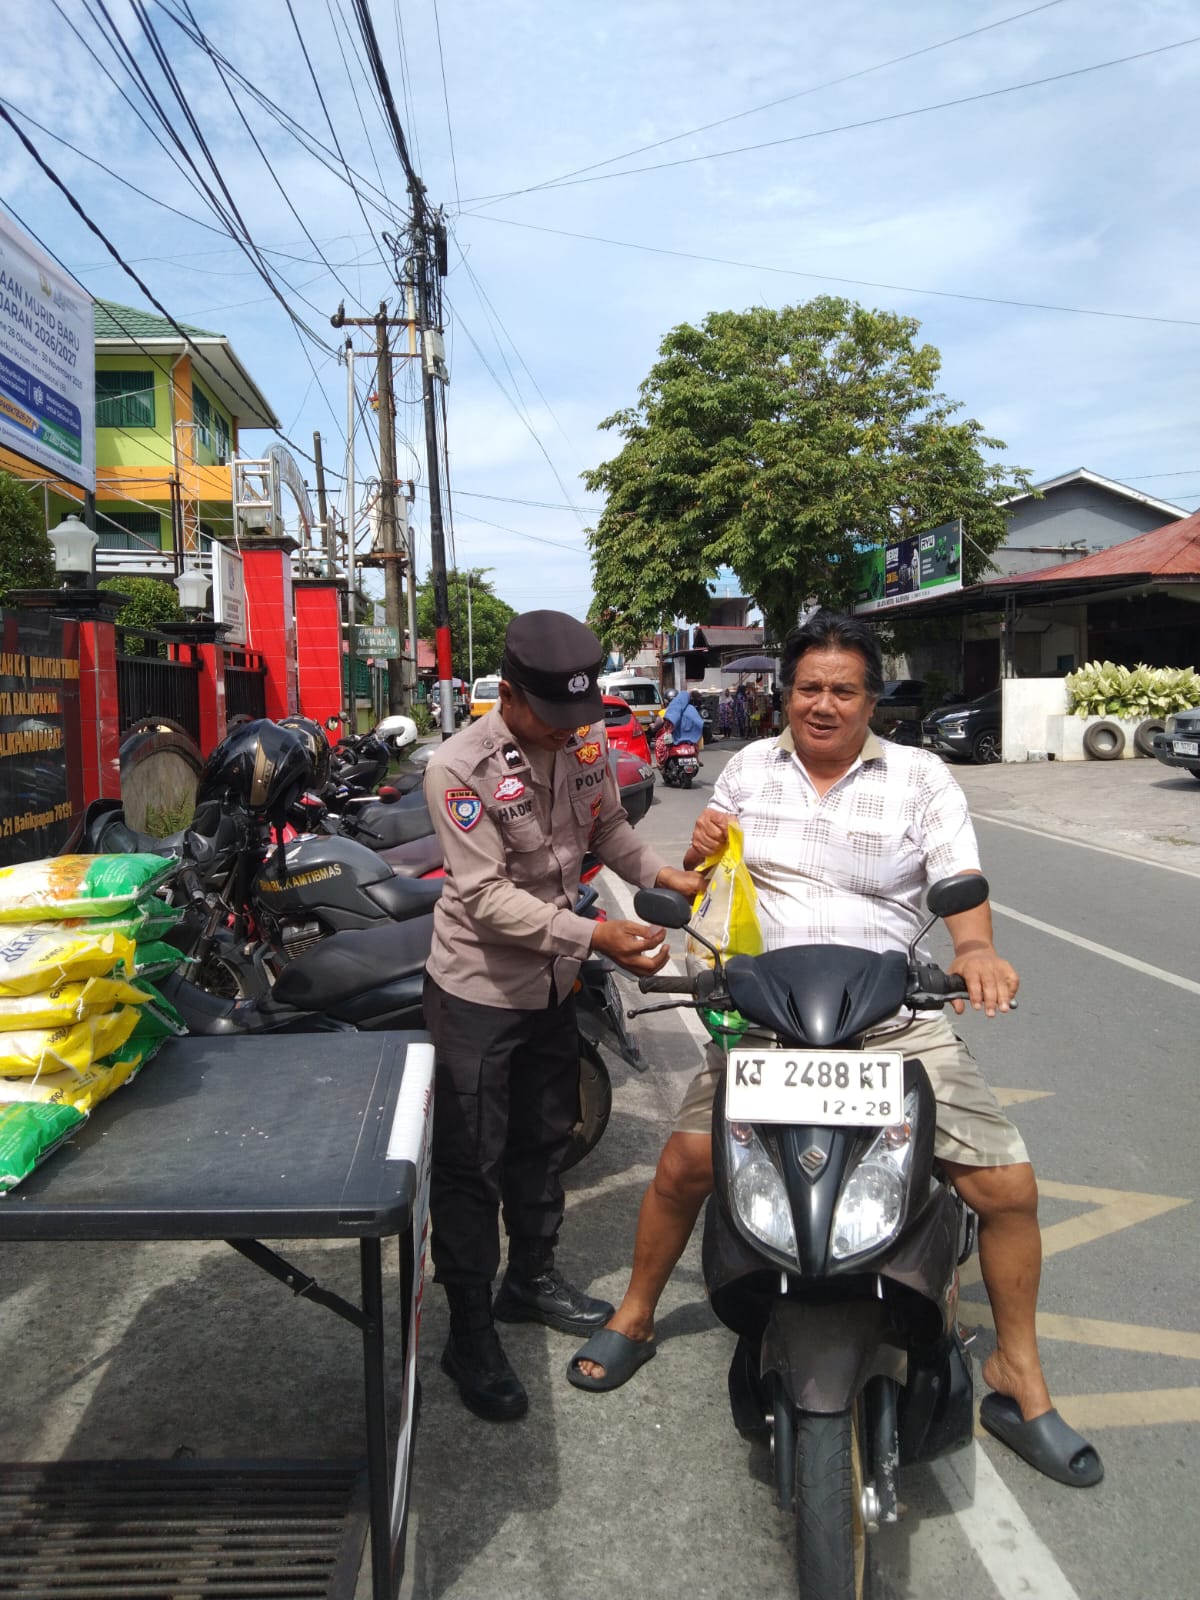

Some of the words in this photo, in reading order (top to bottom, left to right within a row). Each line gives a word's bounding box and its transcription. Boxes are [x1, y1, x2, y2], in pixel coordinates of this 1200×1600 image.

[25, 290, 55, 330] MURID
[57, 320, 79, 351] BARU
[34, 321, 77, 368] 2026/2027
[13, 692, 58, 715] BALIKPAPAN
[14, 811, 54, 834] Balikpapan
[784, 1060, 850, 1089] 2488
[859, 1062, 891, 1089] KT
